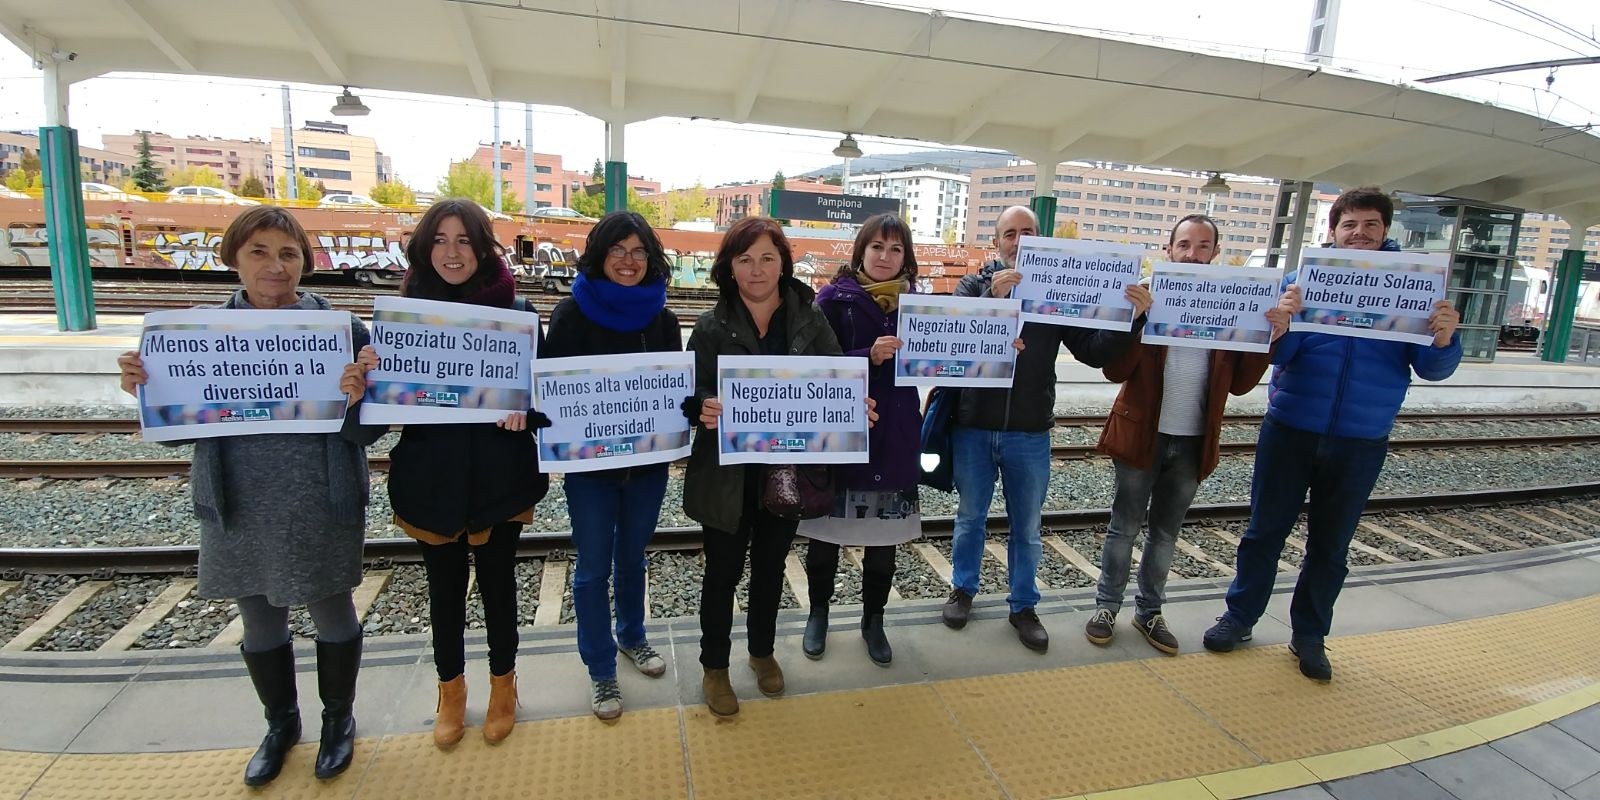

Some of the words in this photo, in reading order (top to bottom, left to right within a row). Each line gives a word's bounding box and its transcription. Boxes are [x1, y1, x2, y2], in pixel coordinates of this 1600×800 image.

[817, 196, 862, 210] Pamplona
[826, 209, 852, 220] Iruña
[1022, 253, 1058, 267] ¡Menos
[1062, 256, 1081, 269] alta
[1086, 258, 1134, 275] velocidad,
[1032, 271, 1052, 283] más
[1056, 274, 1100, 288] atención
[1103, 280, 1108, 288] a
[1112, 278, 1122, 290] la
[1156, 278, 1192, 292] ¡Menos
[1196, 280, 1216, 293] alta
[1220, 282, 1273, 298] velocidad,
[1308, 269, 1379, 287] Negoziatu
[1384, 274, 1436, 293] Solana,
[1046, 288, 1102, 304] diversidad!
[1165, 295, 1186, 307] más
[1190, 298, 1235, 310] atención
[1239, 302, 1245, 311] a
[1248, 300, 1258, 312] la
[1305, 288, 1354, 304] hobetu
[1357, 294, 1390, 308] gure
[1395, 295, 1432, 311] lana!
[908, 318, 966, 335] Negoziatu
[970, 320, 1009, 336] Solana,
[1180, 312, 1238, 327] diversidad!
[145, 335, 209, 356] ¡Menos
[215, 334, 250, 352] alta
[256, 334, 342, 353] velocidad,
[373, 326, 455, 349] Negoziatu
[462, 332, 521, 357] Solana,
[908, 338, 947, 352] hobetu
[951, 342, 976, 356] gure
[980, 340, 1007, 355] lana!
[168, 360, 206, 377] más
[212, 360, 288, 377] atención
[295, 364, 304, 375] a
[310, 359, 325, 375] la
[436, 361, 474, 378] gure
[480, 360, 519, 380] lana!
[204, 383, 298, 400] diversidad!
[542, 380, 590, 400] ¡Menos
[596, 377, 620, 393] alta
[625, 373, 688, 392] velocidad,
[732, 382, 801, 402] Negoziatu
[807, 382, 856, 401] Solana,
[560, 400, 588, 418] más
[592, 396, 648, 415] atención
[652, 400, 660, 410] a
[664, 395, 675, 410] la
[732, 407, 781, 424] hobetu
[786, 410, 817, 426] gure
[823, 406, 855, 423] lana!
[585, 417, 655, 438] diversidad!
